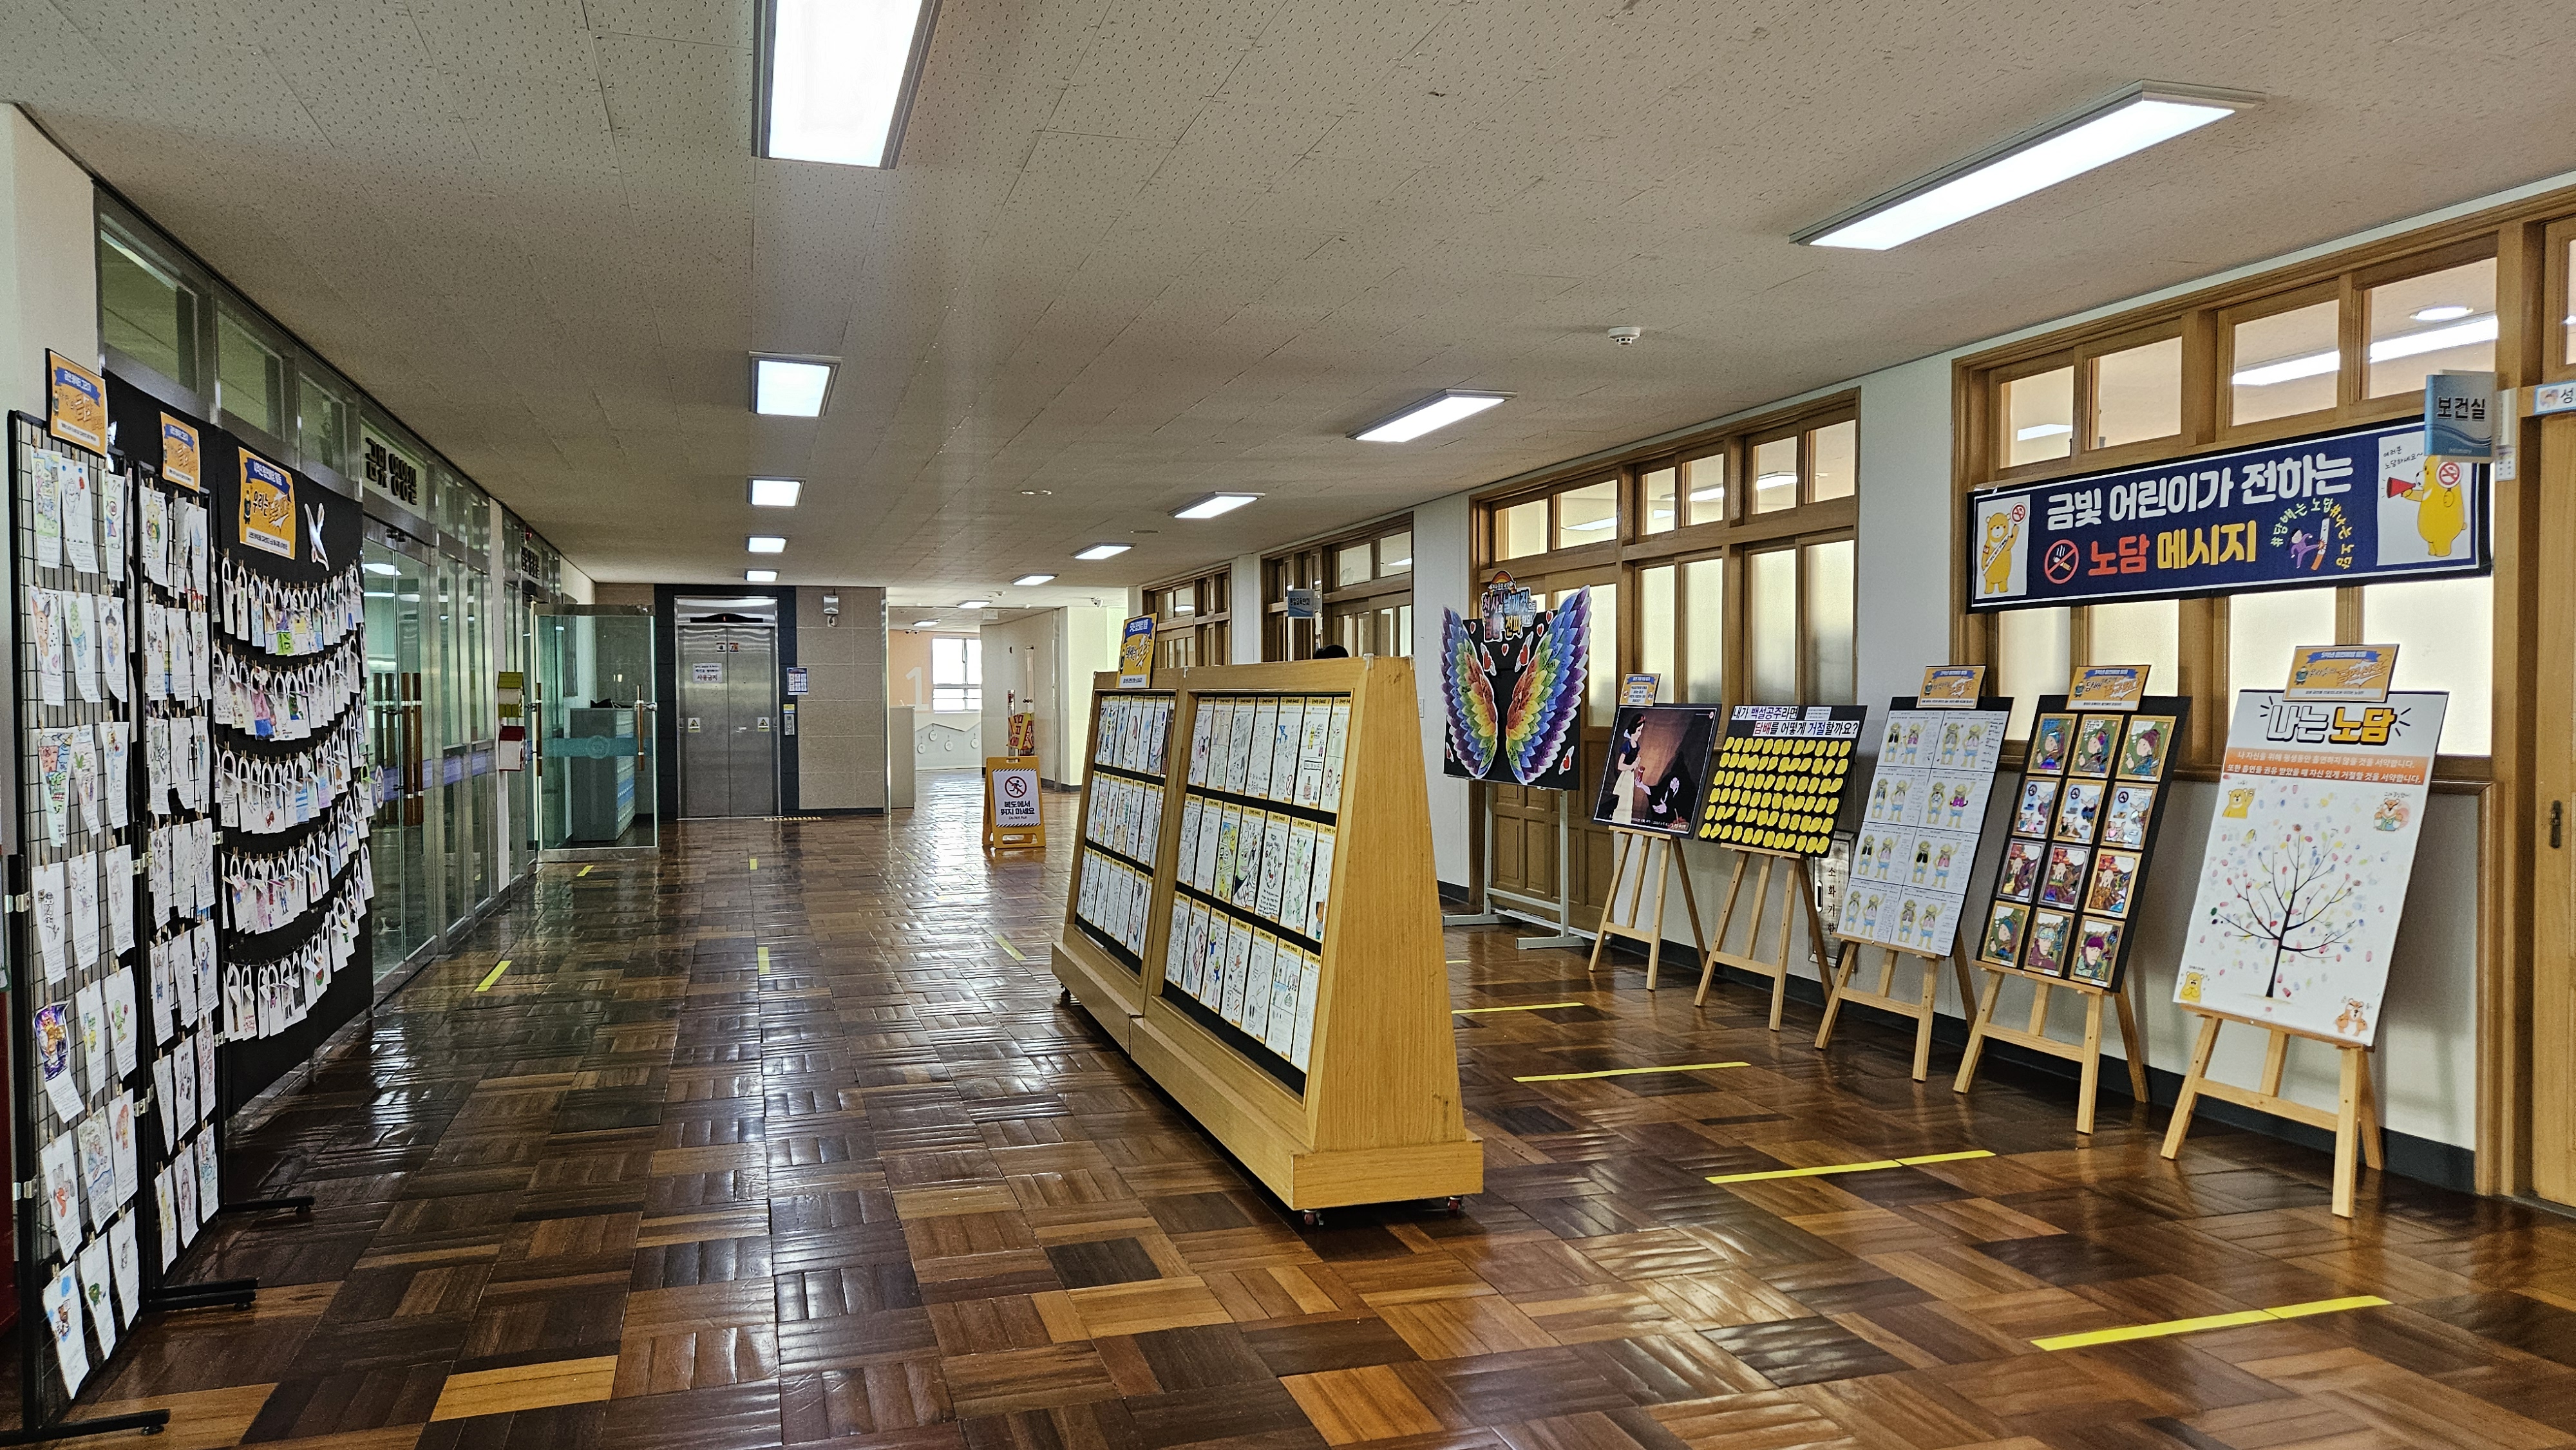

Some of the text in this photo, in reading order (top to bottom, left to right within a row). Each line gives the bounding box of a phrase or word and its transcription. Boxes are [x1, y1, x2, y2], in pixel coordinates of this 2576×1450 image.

[2560, 387, 2576, 404] 성
[2437, 396, 2485, 420] 보건실
[2383, 446, 2402, 457] 여러분
[2047, 452, 2353, 531] 금빛 어린이가 전하는
[253, 491, 269, 517] 우리는
[2311, 498, 2333, 513] 노담
[2088, 520, 2257, 576] 노담 메시지
[2336, 543, 2354, 569] 노담
[905, 667, 929, 711] 1
[1733, 706, 1749, 719] 내가
[1750, 706, 1799, 720] 백설공주라면
[1755, 722, 1858, 736] 담배를 어떻게 거절할까요?
[2266, 705, 2398, 746] 나는 노담
[2238, 751, 2414, 769] 나 자신을 위해 평생동안 흡연하지 않을 것을 서약합니다.
[2227, 764, 2241, 772] 또한
[2242, 764, 2262, 774] 흡연을
[2264, 766, 2277, 775] 권유
[2279, 767, 2299, 777] 받았을
[2309, 769, 2324, 778] 자신
[2325, 770, 2340, 779] 있게
[2341, 771, 2363, 781] 거절할
[2365, 772, 2380, 781] 것을
[2381, 773, 2421, 784] 서약합니다.
